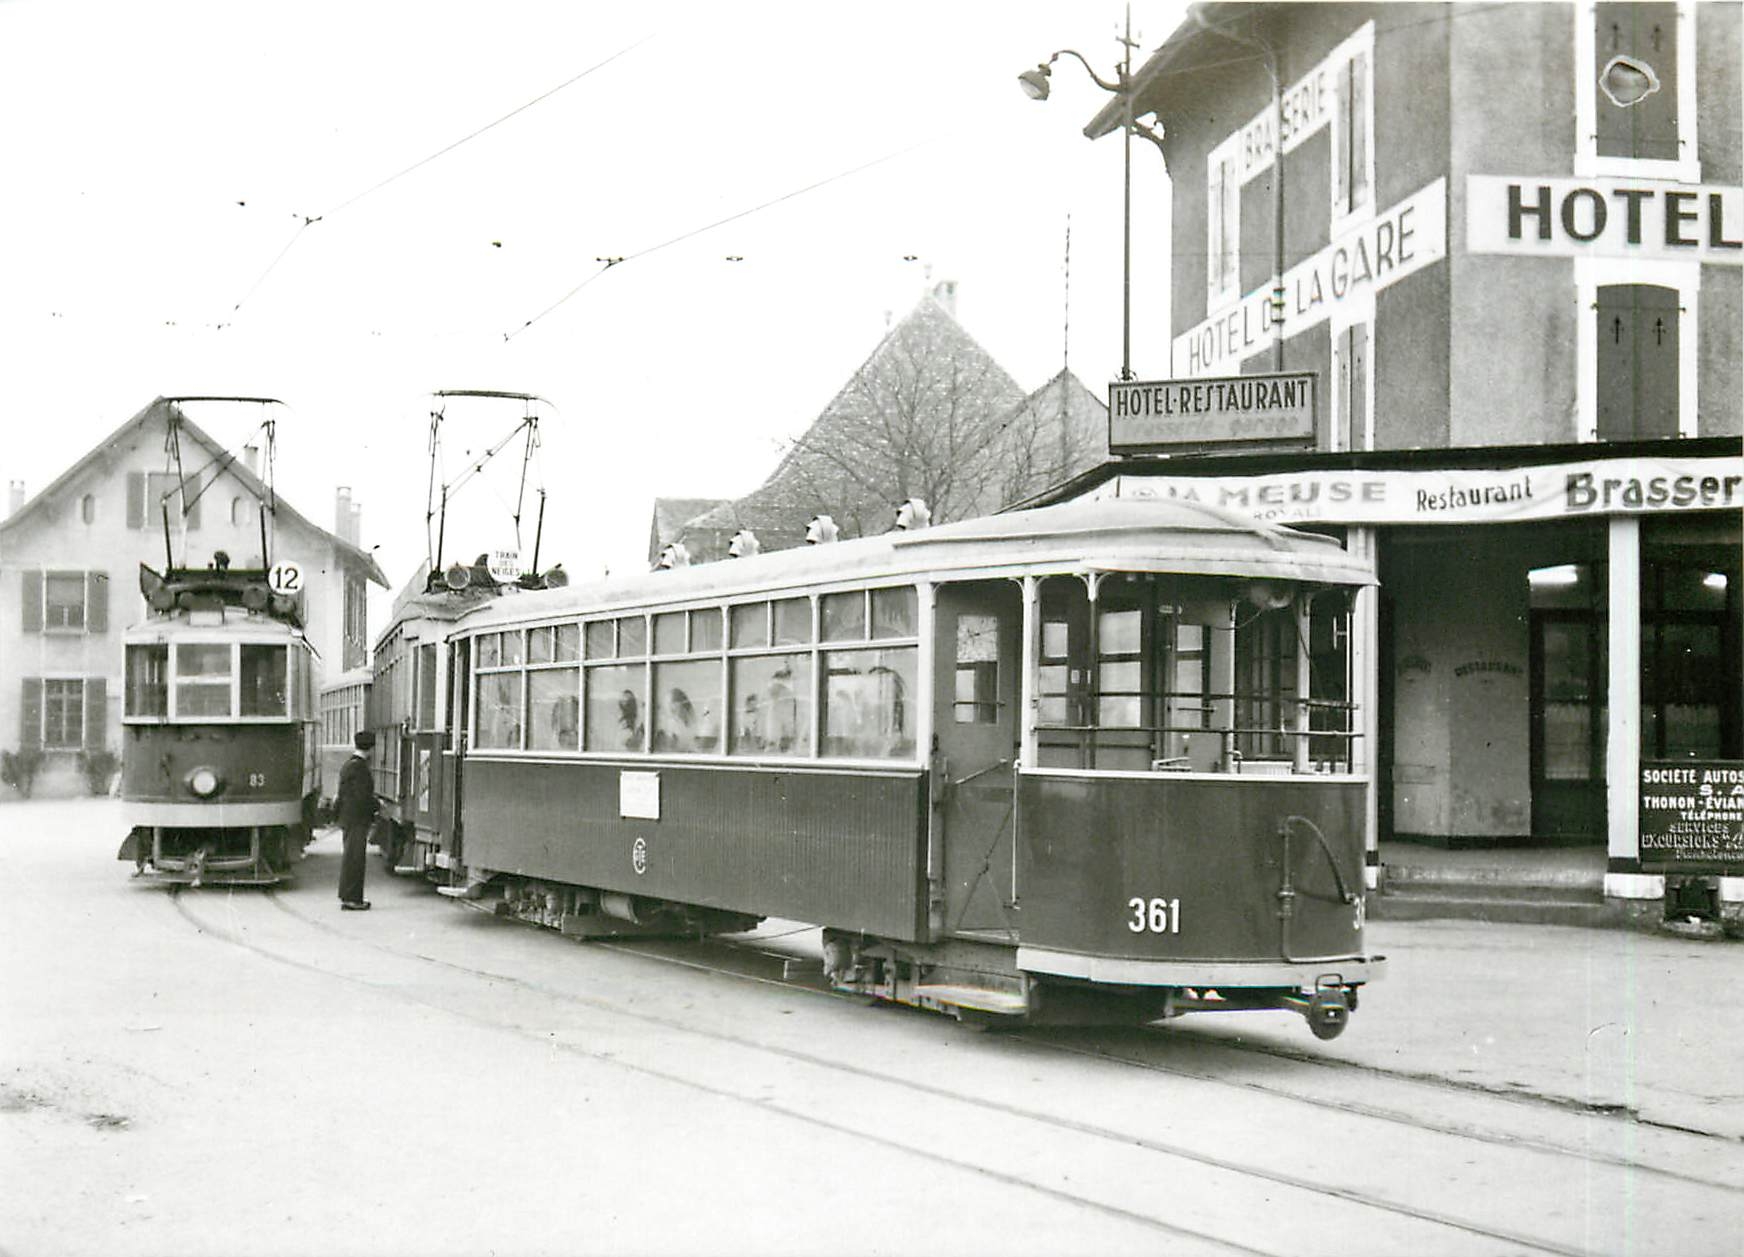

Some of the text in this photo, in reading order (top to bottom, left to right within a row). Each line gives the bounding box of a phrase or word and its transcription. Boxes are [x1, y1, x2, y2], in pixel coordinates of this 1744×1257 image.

[1507, 184, 1742, 249] HOTEL
[1189, 304, 1255, 376] HOTEL
[1296, 269, 1323, 316] LA
[1331, 205, 1415, 300] GARE
[1219, 481, 1387, 507] MEUSE
[1416, 475, 1533, 512] Restaurant
[275, 567, 299, 590] 12
[1127, 896, 1181, 934] 361
